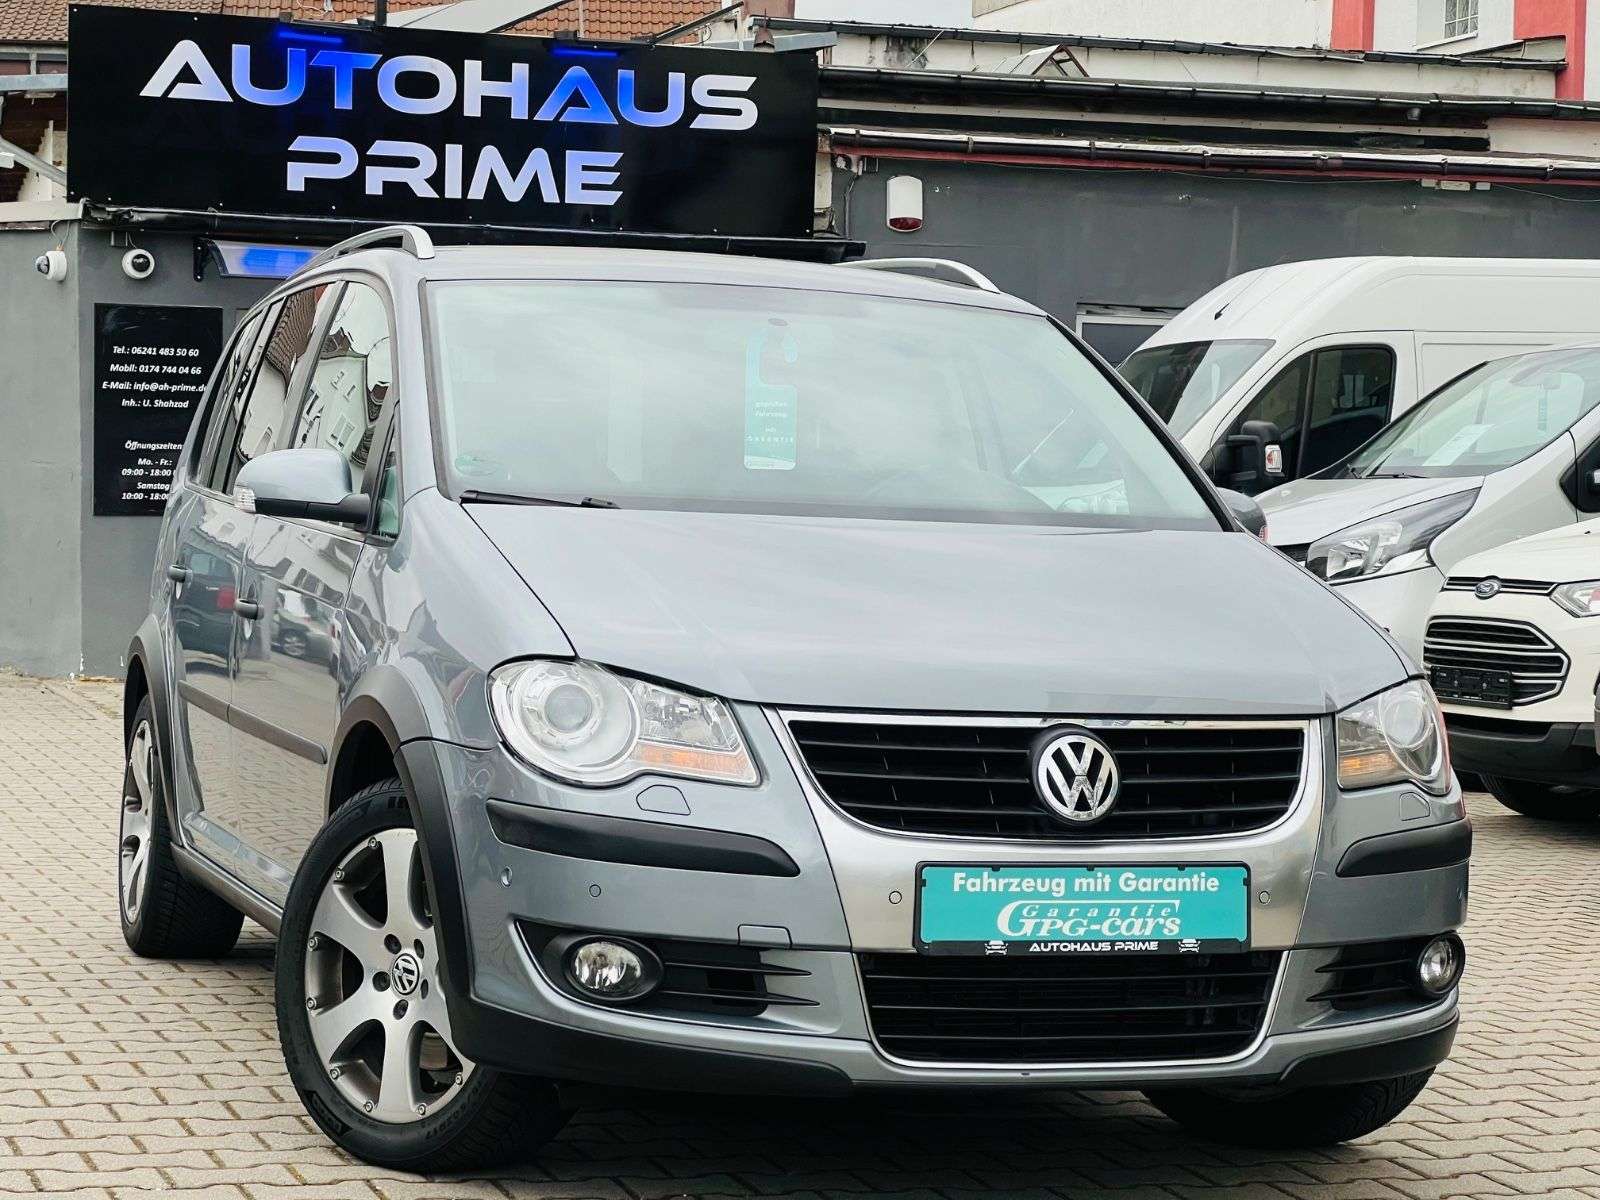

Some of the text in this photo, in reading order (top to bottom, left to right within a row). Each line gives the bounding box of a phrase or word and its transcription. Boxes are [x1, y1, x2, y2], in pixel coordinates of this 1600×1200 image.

[139, 39, 758, 131] AUTOHAUS
[287, 135, 624, 206] PRIME
[113, 346, 199, 357] Tel.: 06241 483 50 60
[109, 364, 202, 375] Mobil: 0174 744 04 66
[102, 382, 132, 390] E-Mail:
[121, 399, 141, 407] Inh.:
[153, 400, 189, 408] Shahzad
[159, 458, 173, 466] Fr.:
[122, 468, 144, 476] 09:00
[122, 492, 144, 500] 10:00
[953, 872, 1220, 897] Fahrzeug mit Garantie
[1022, 904, 1171, 917] Garantie
[1029, 942, 1159, 952] AUTOHAUS PRIME
